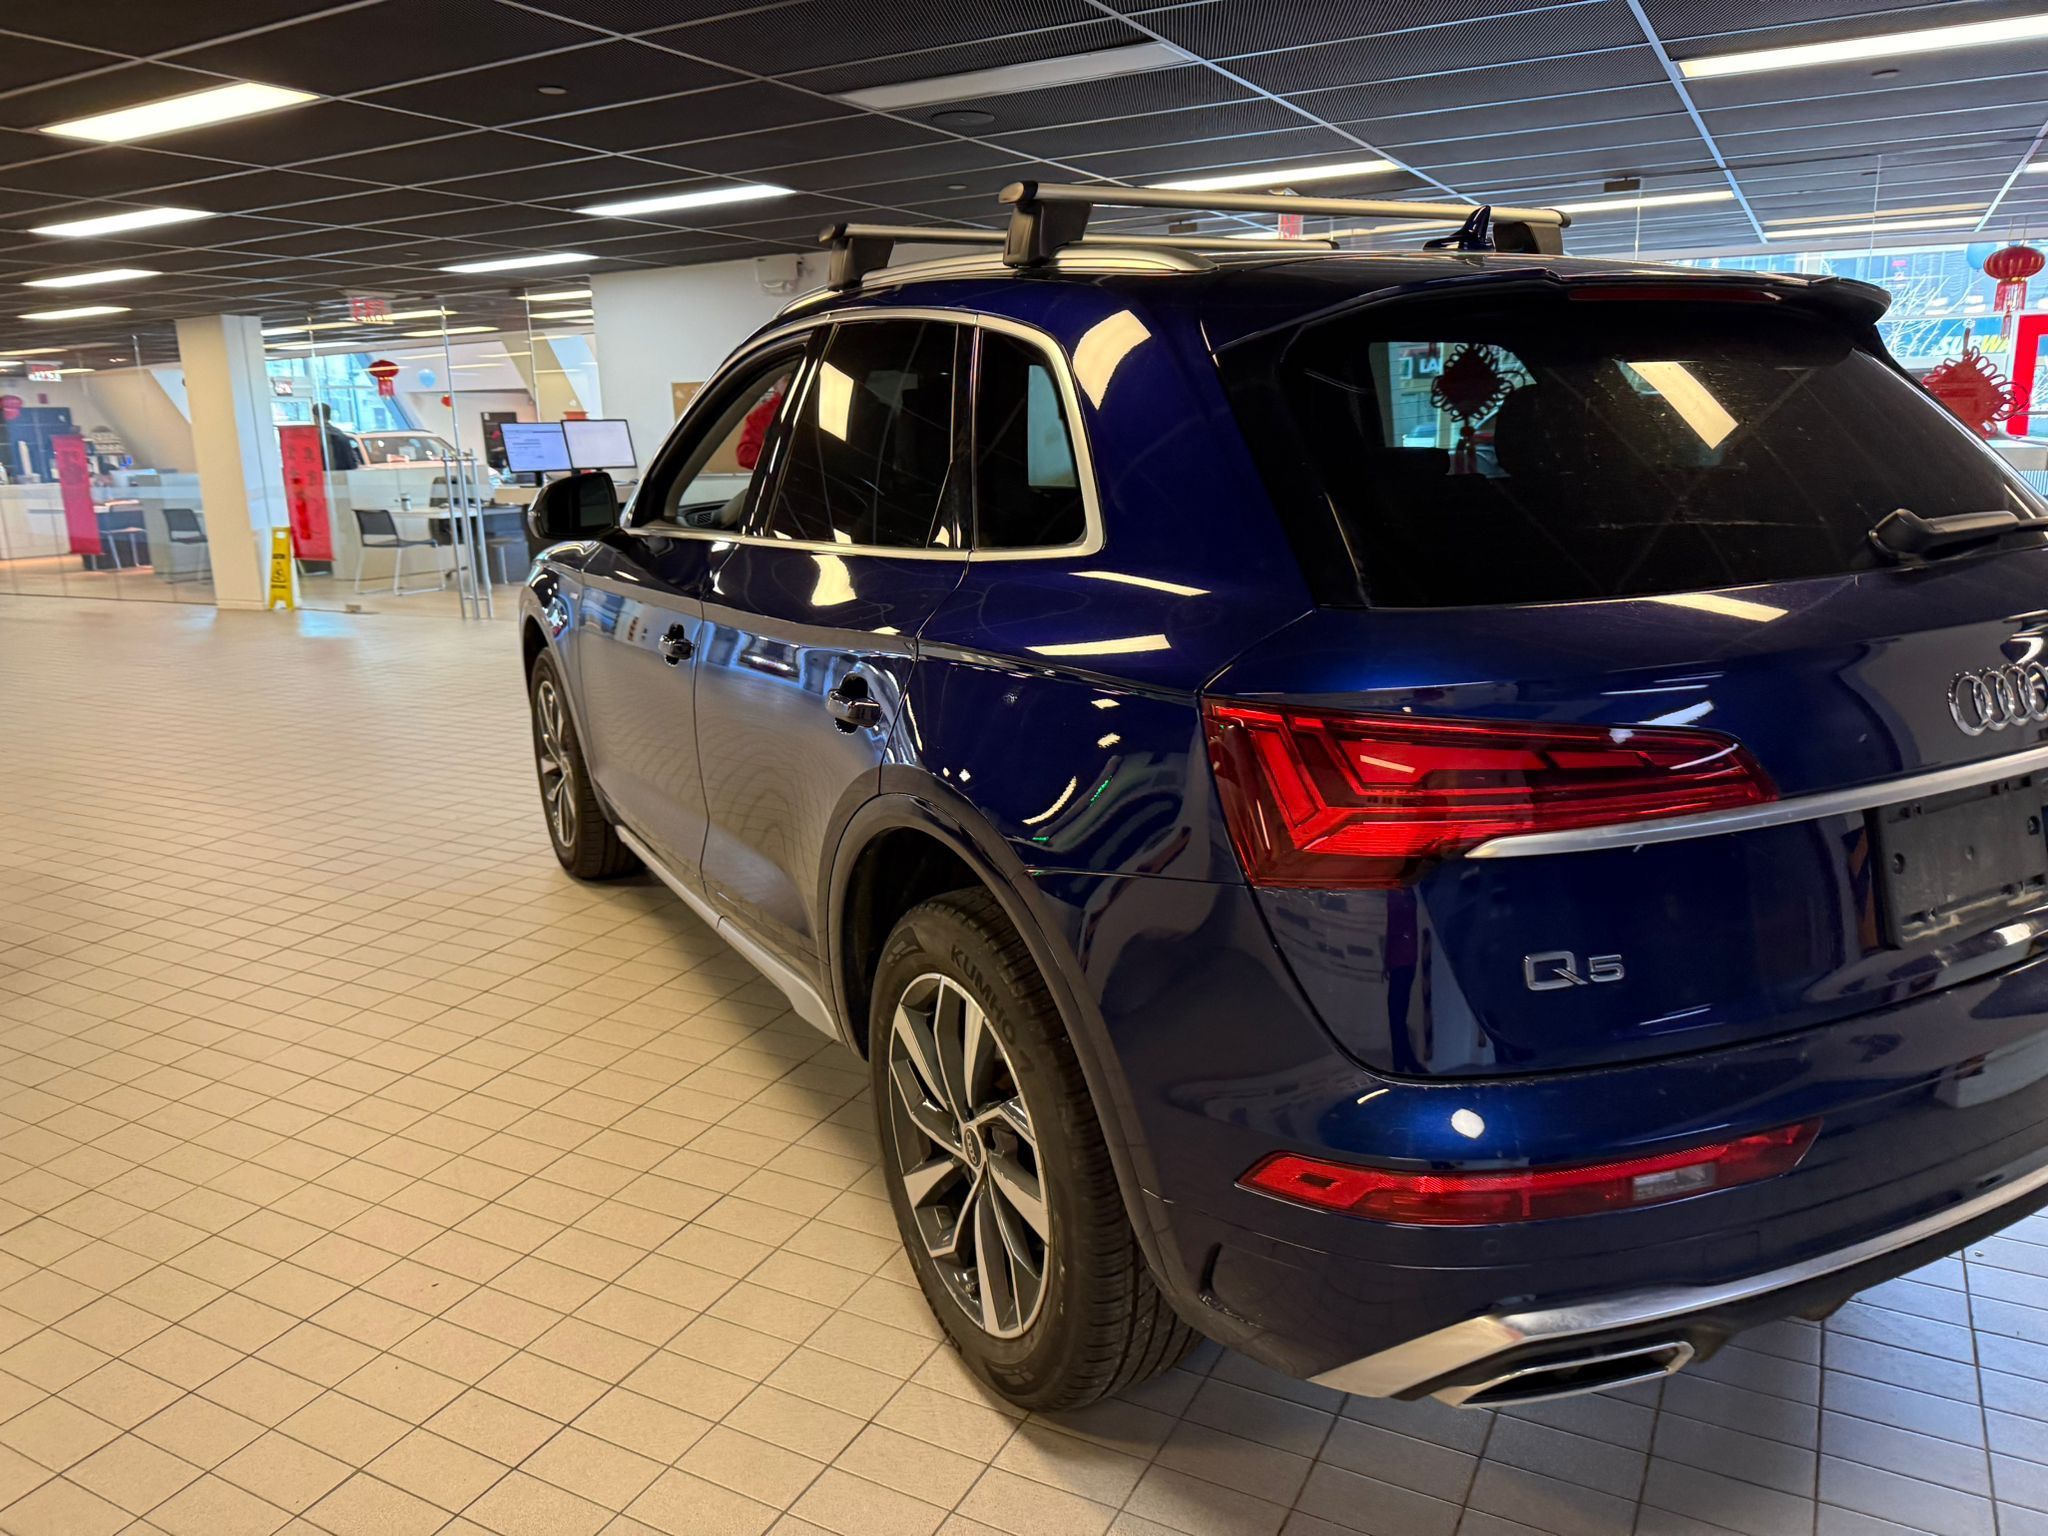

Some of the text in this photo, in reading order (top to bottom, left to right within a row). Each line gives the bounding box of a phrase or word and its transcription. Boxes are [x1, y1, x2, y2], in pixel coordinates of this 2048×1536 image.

[1935, 334, 2010, 356] SUBWA
[1524, 951, 1625, 991] Q5
[950, 943, 1016, 1047] KUMHO
